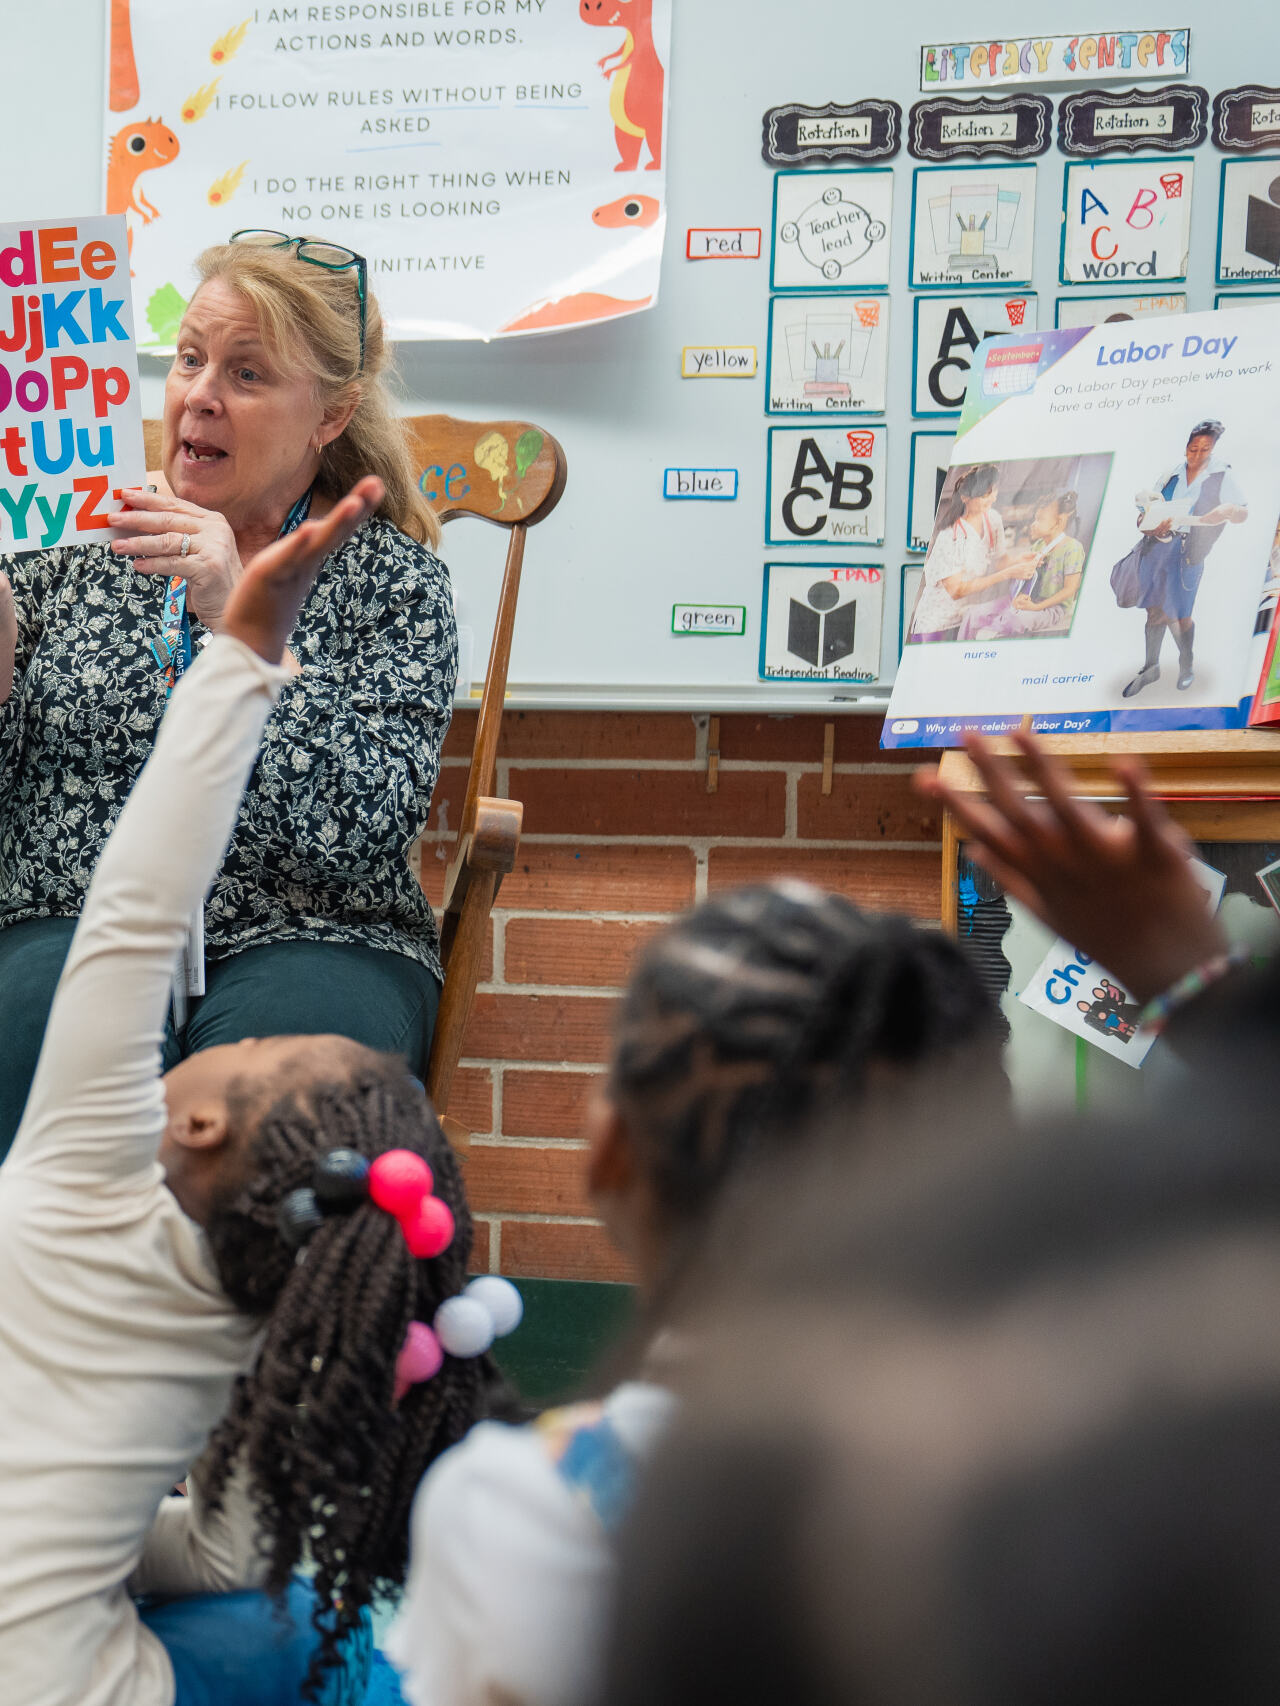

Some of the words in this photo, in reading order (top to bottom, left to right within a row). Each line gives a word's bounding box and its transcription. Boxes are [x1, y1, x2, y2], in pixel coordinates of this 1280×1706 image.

[254, 9, 259, 23] I
[267, 8, 298, 23] AM
[307, 2, 455, 22] RESPONSIBLE
[464, 0, 505, 15] FOR
[516, 0, 546, 13] MY
[275, 33, 372, 52] ACTIONS
[380, 31, 426, 48] AND
[434, 28, 524, 46] WORDS.
[215, 95, 220, 111] I
[228, 91, 319, 110] FOLLOW
[327, 89, 394, 107] RULES
[402, 85, 507, 104] WITHOUT
[515, 83, 584, 101] BEING
[360, 116, 431, 134] ASKED
[798, 120, 860, 141] Rotation
[942, 119, 995, 138] Rotation
[1000, 121, 1013, 137] 2
[1095, 113, 1149, 130] Rotation
[1157, 114, 1167, 128] 3
[254, 178, 259, 194] I
[267, 177, 297, 194] DO
[306, 176, 346, 192] THE
[354, 173, 421, 191] RIGHT
[428, 171, 497, 189] THING
[504, 169, 572, 188] WHEN
[281, 205, 312, 221] NO
[321, 203, 365, 220] ONE
[373, 202, 392, 219] IS
[400, 199, 501, 218] LOOKING
[1081, 188, 1109, 225] A
[1126, 188, 1158, 230] B
[705, 231, 744, 253] red
[821, 231, 854, 253] lead
[1090, 225, 1119, 261] C
[373, 255, 487, 273] INITIATIVE
[1083, 250, 1157, 280] word
[920, 271, 963, 285] Writing
[971, 267, 1013, 281] Center
[938, 306, 980, 359] A
[693, 348, 749, 373] yellow
[1096, 340, 1173, 366] Labor
[1182, 335, 1238, 359] Day
[928, 357, 971, 408] C
[1054, 383, 1072, 396] On
[1077, 379, 1118, 394] Labor
[1121, 376, 1148, 392] Day
[1152, 371, 1201, 387] people
[1204, 367, 1233, 380] who
[1238, 361, 1273, 376] work
[771, 397, 813, 412] Writing
[826, 396, 866, 409] Center
[1049, 401, 1080, 414] have
[1084, 402, 1093, 411] a
[1098, 396, 1123, 410] day
[1127, 395, 1141, 407] of
[1145, 393, 1174, 405] rest.
[791, 437, 834, 488] A
[676, 471, 724, 494] blue
[829, 461, 874, 511] B
[782, 486, 828, 537] C
[830, 515, 869, 537] Word
[828, 567, 881, 584] IPAD
[682, 611, 736, 631] green
[175, 648, 186, 677] Every
[963, 649, 998, 660] nurse
[765, 664, 830, 680] Independent
[1021, 673, 1049, 686] mail
[1051, 671, 1095, 685] carrier
[925, 722, 947, 735] Why
[948, 721, 962, 733] do
[964, 723, 980, 732] we
[981, 720, 1023, 732] celebrat
[1030, 720, 1062, 731] Labor
[1062, 718, 1092, 732] Day?
